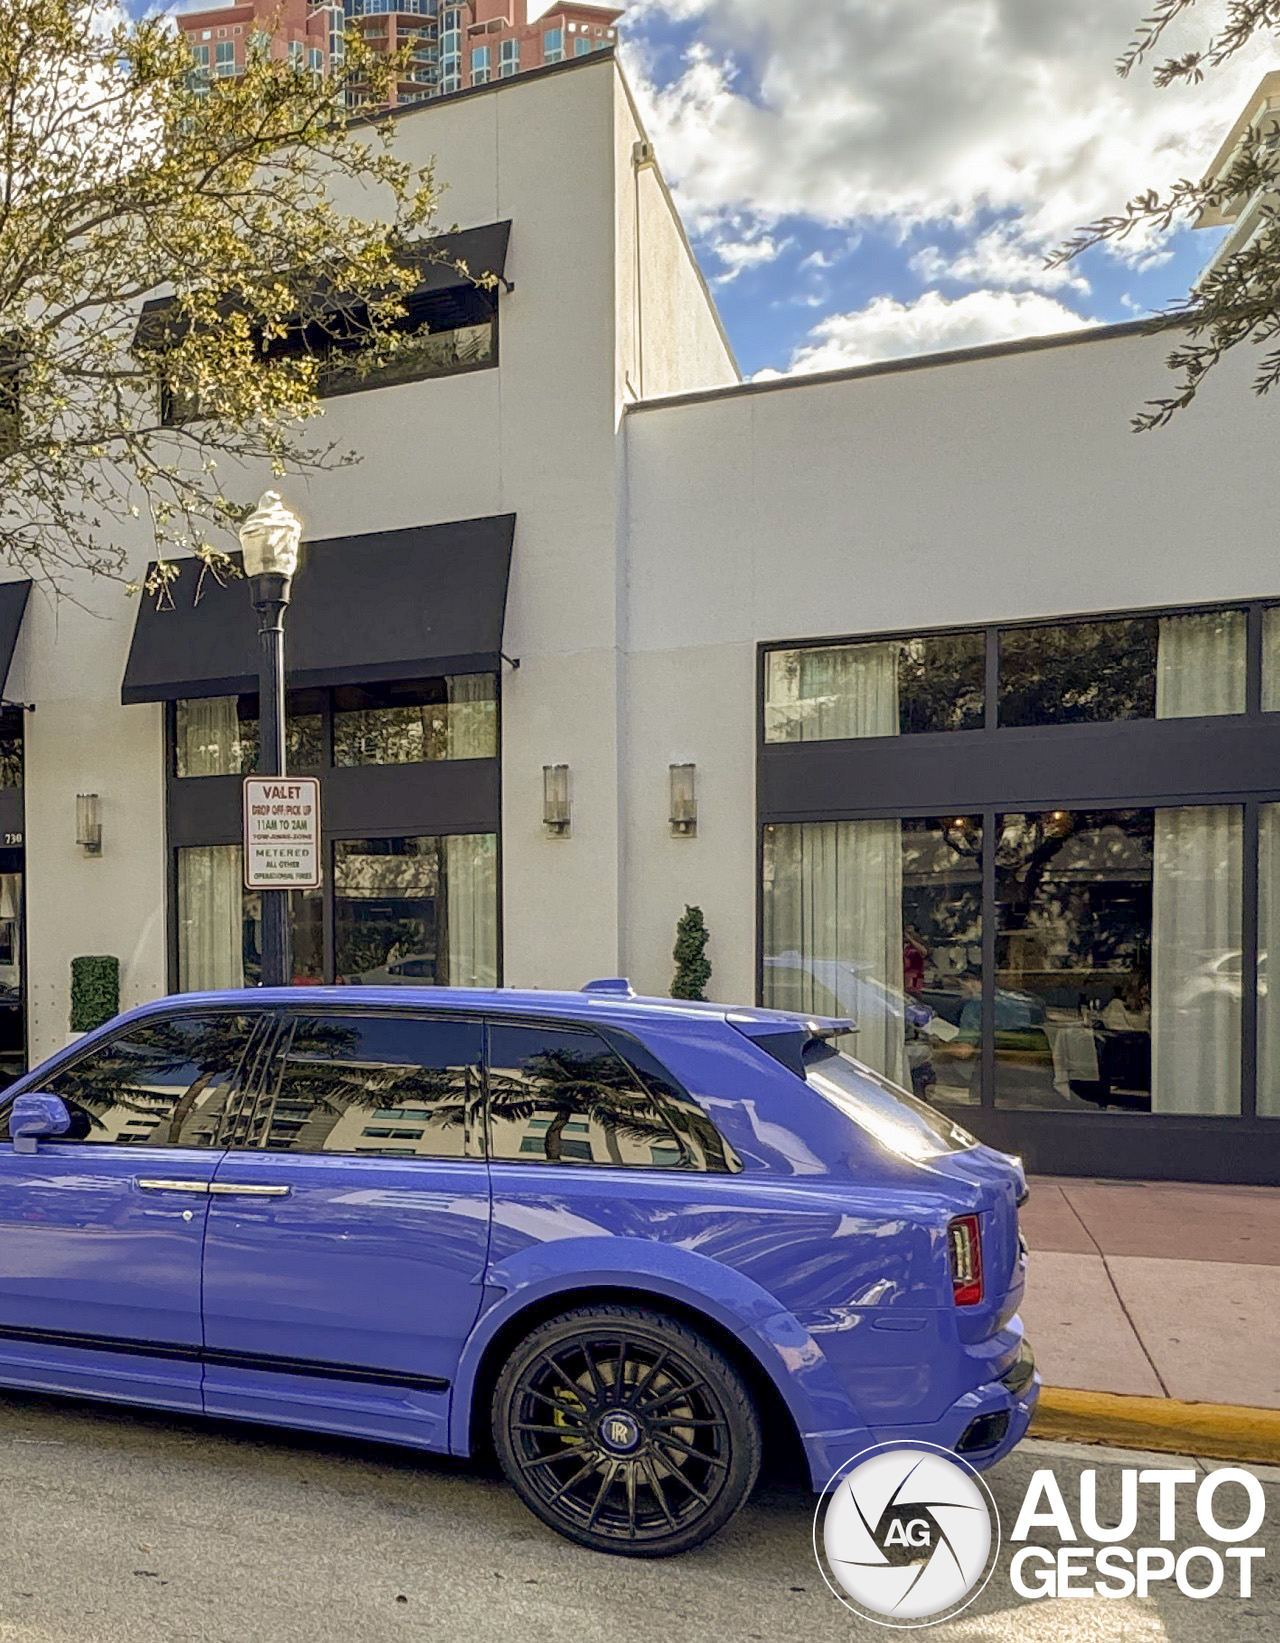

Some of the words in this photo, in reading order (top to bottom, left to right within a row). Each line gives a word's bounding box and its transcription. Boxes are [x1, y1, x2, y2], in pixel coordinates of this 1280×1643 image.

[262, 786, 300, 799] VALET
[252, 805, 270, 815] DROP
[303, 805, 312, 816] UP
[257, 820, 278, 830] 11AM
[280, 820, 290, 830] TO
[292, 820, 308, 830] 2AM
[5, 833, 22, 844] 730
[256, 848, 310, 857] METERED
